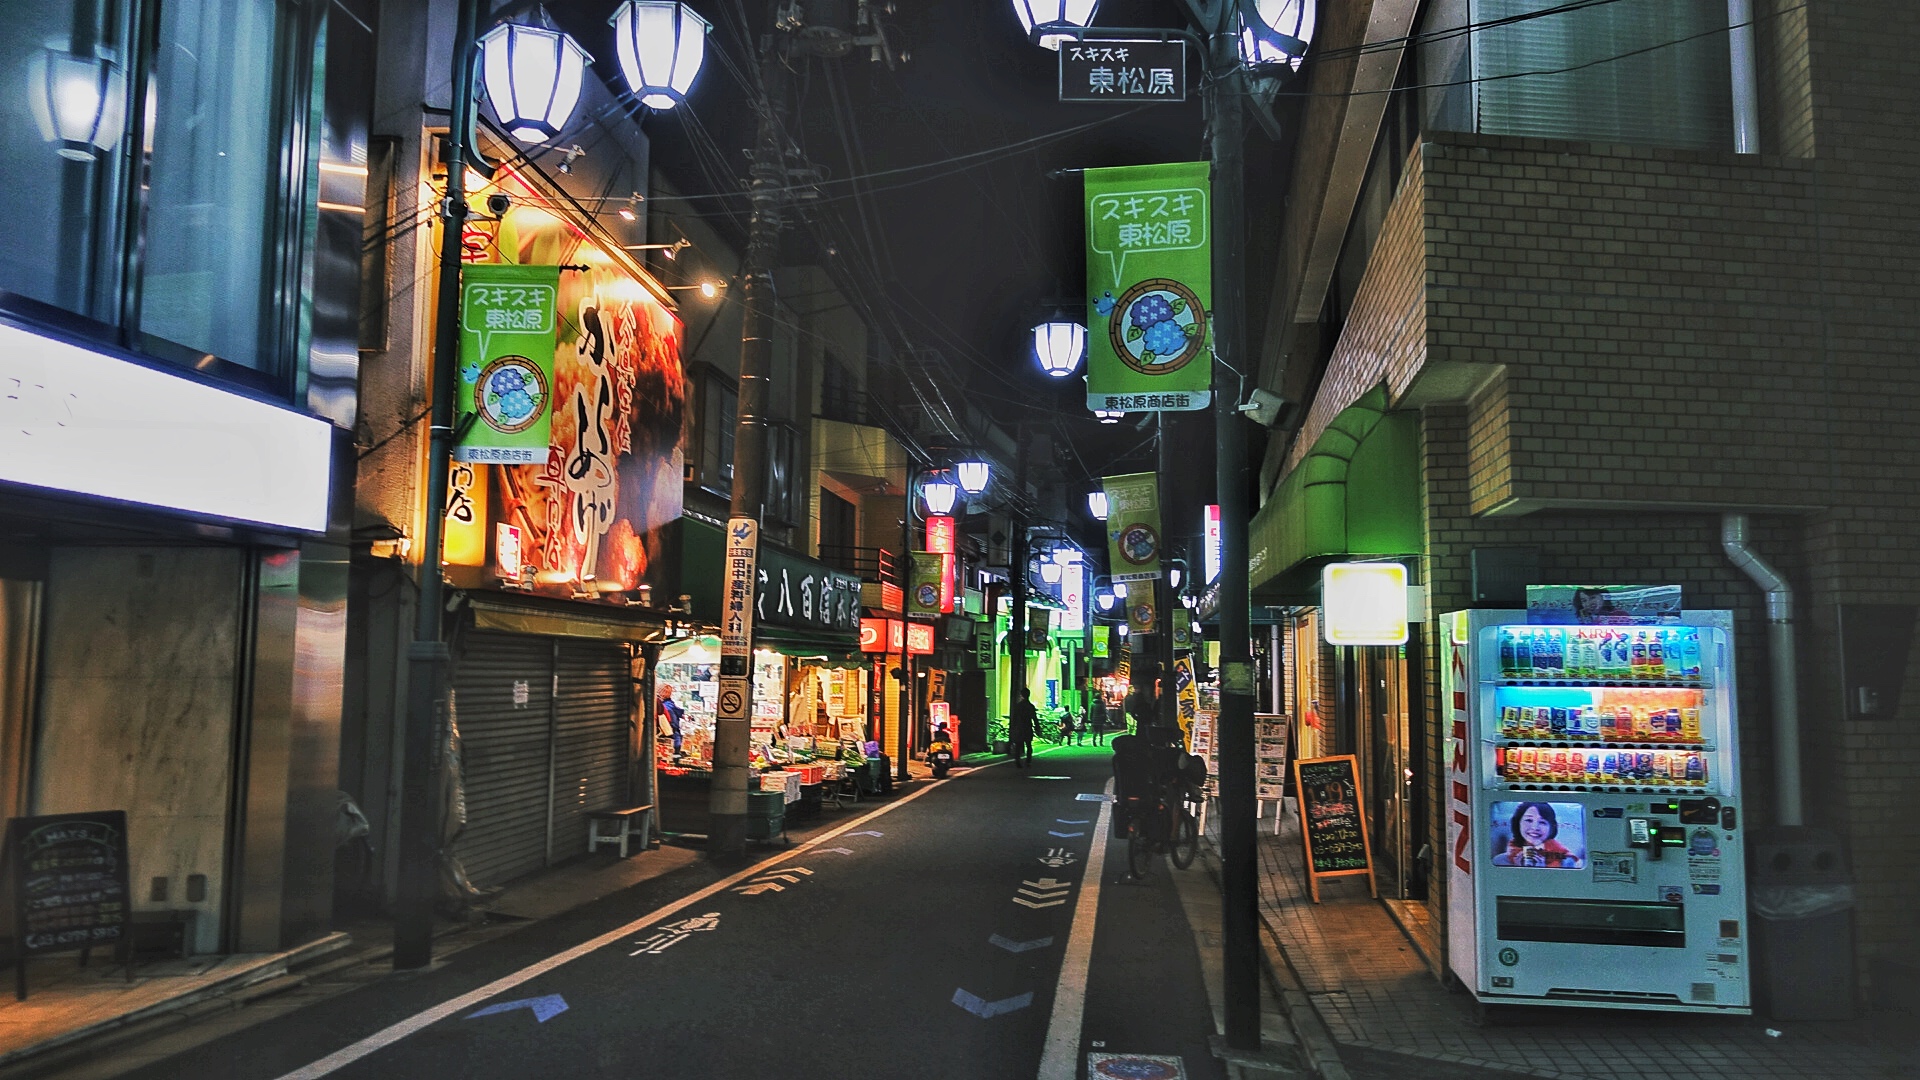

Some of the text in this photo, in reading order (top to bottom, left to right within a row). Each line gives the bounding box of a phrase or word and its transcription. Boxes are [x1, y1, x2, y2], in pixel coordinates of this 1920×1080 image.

[1070, 47, 1129, 62] スキスキ
[1089, 66, 1175, 95] 東松原
[1099, 194, 1195, 221] スキスキ
[1118, 219, 1192, 248] 東松原
[472, 288, 545, 307] スキスキ
[484, 309, 543, 330] 東松原
[1105, 394, 1190, 410] 東松原商店街
[467, 448, 533, 462] 東松原商店街
